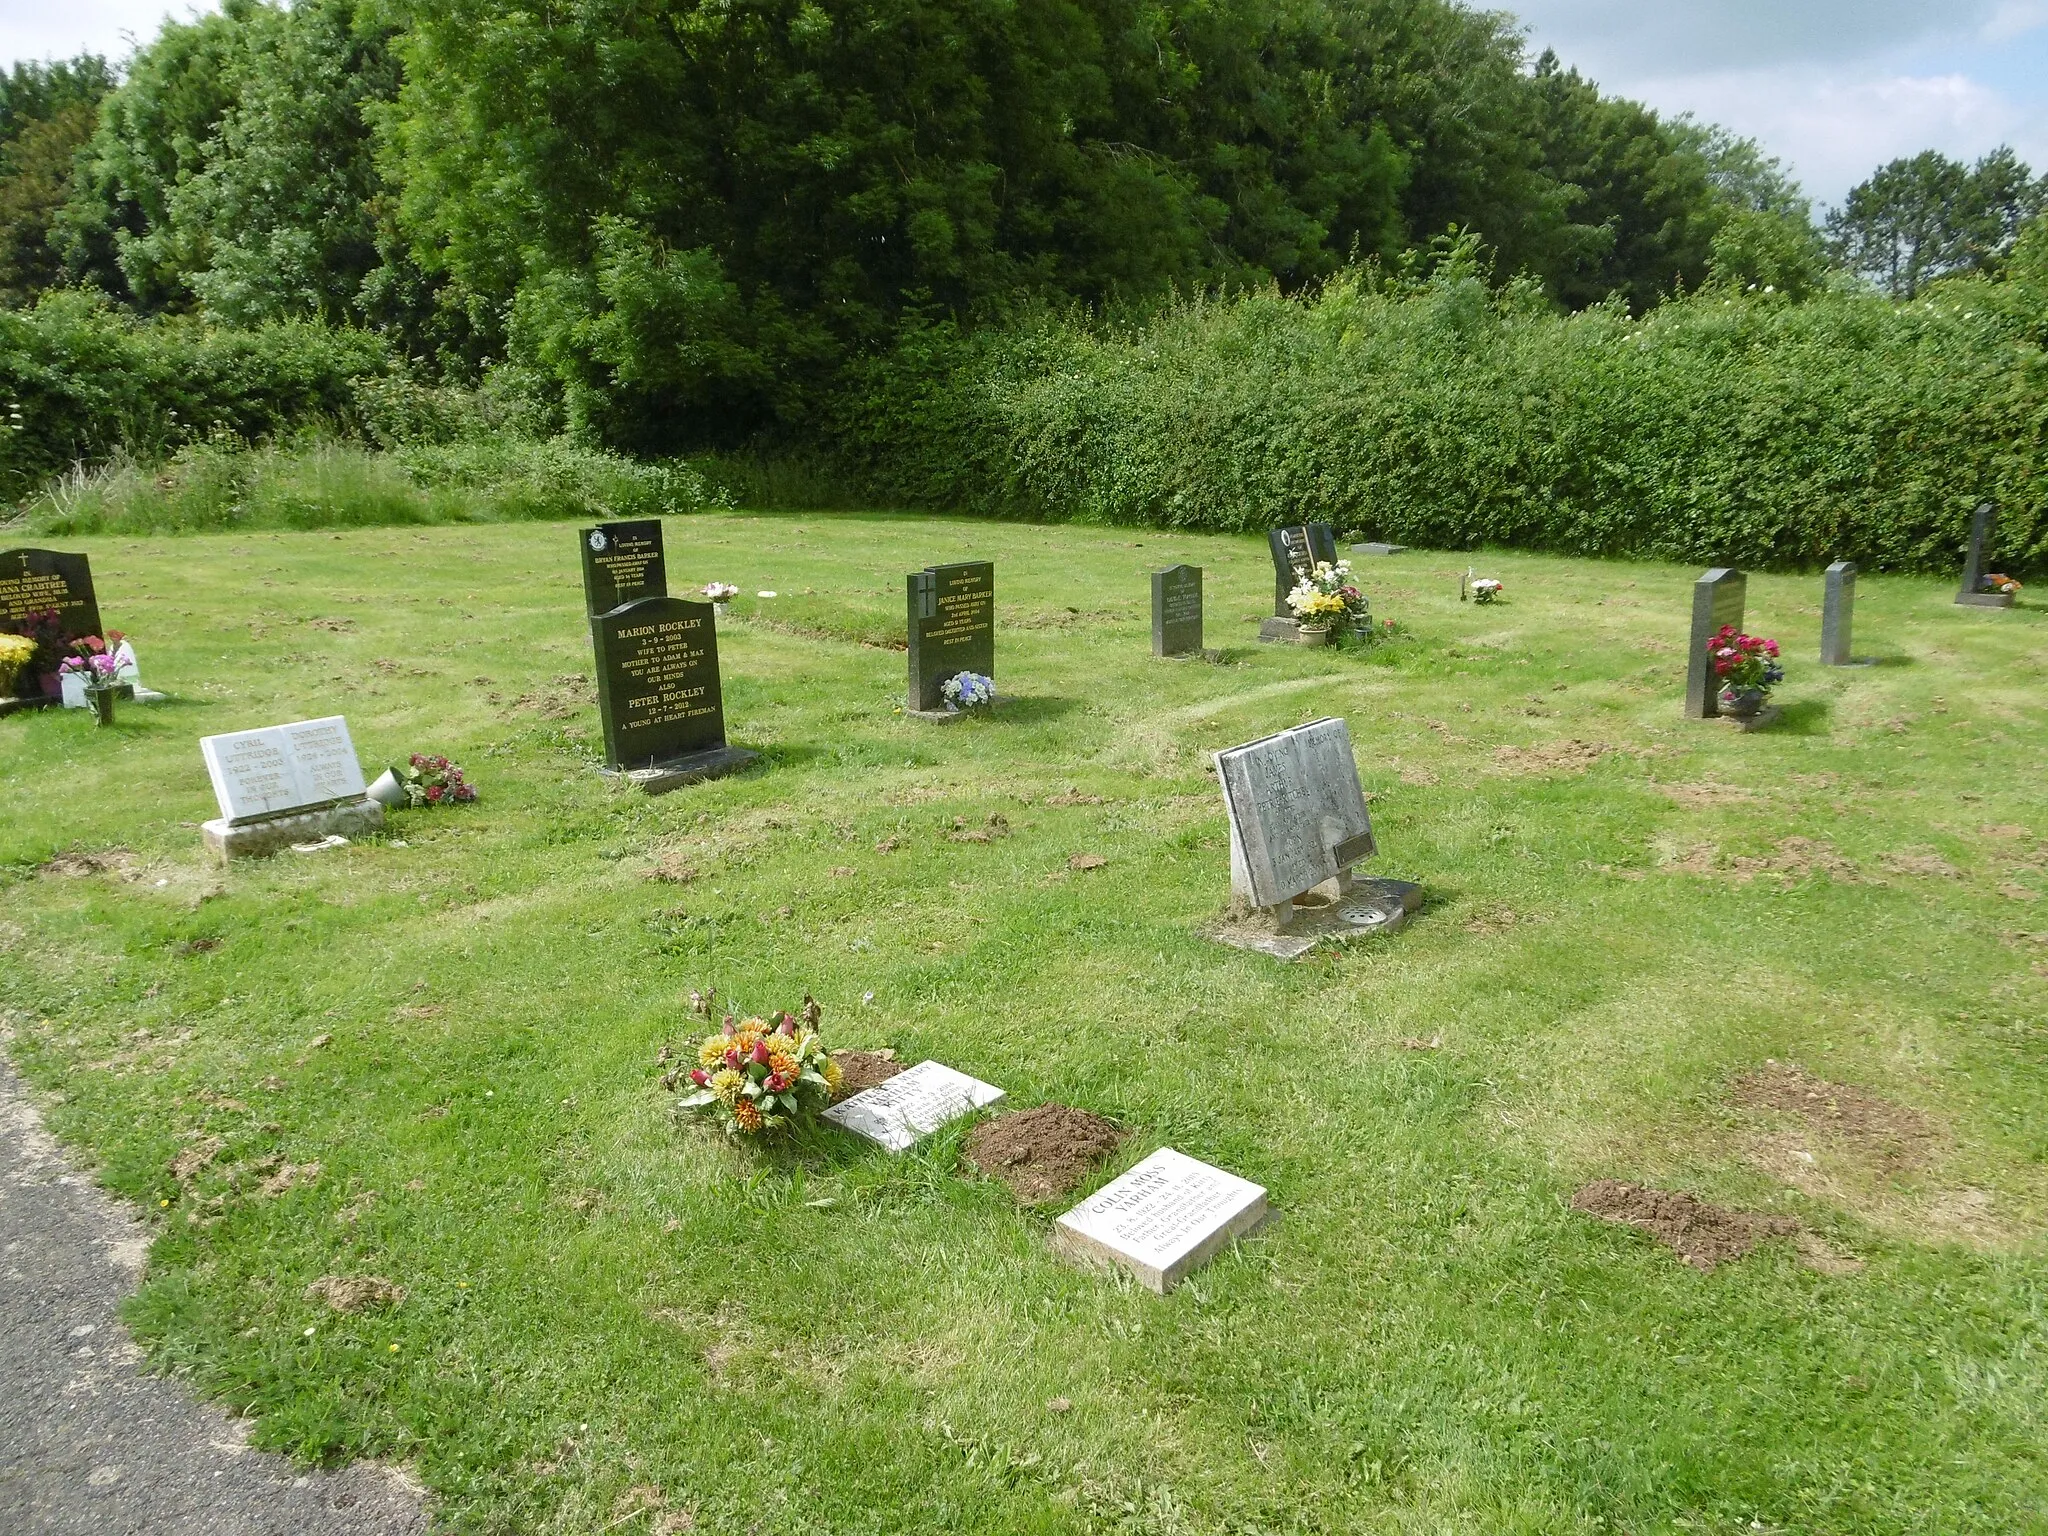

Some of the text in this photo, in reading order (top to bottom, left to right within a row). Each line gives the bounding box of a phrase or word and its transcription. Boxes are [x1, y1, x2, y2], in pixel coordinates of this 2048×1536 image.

[21, 580, 67, 591] CRABTREE
[957, 593, 972, 601] MARY
[972, 591, 992, 599] BARKER
[617, 619, 702, 639] MARION ROCKLEY
[637, 647, 654, 656] WIFE
[668, 643, 688, 651] PETER
[622, 658, 649, 668] MOTHER
[662, 662, 687, 671] ALWAYS
[664, 672, 684, 680] MINDS
[659, 683, 676, 691] ALSO
[628, 687, 705, 709] PETER ROCKLEY
[629, 718, 651, 729] YOUNG
[664, 711, 685, 722] HEART
[688, 706, 716, 716] FIREMAN
[233, 738, 264, 750] CYRIL
[225, 748, 279, 763] UTTRIDGE
[897, 1064, 930, 1082] MARY
[867, 1080, 919, 1105] YARHAM
[881, 1087, 921, 1108] KITTY
[1091, 1164, 1165, 1213] COLIN MOSS
[1115, 1177, 1168, 1211] YARHAM
[1119, 1216, 1153, 1239] Beloved
[1150, 1194, 1183, 1217] husband
[1190, 1176, 1213, 1188] Kitty
[1132, 1224, 1163, 1242] Father,
[1160, 1191, 1204, 1222] Grandfather
[1154, 1234, 1182, 1253] Always
[1190, 1214, 1206, 1225] Our
[1206, 1189, 1242, 1212] Thoughts
